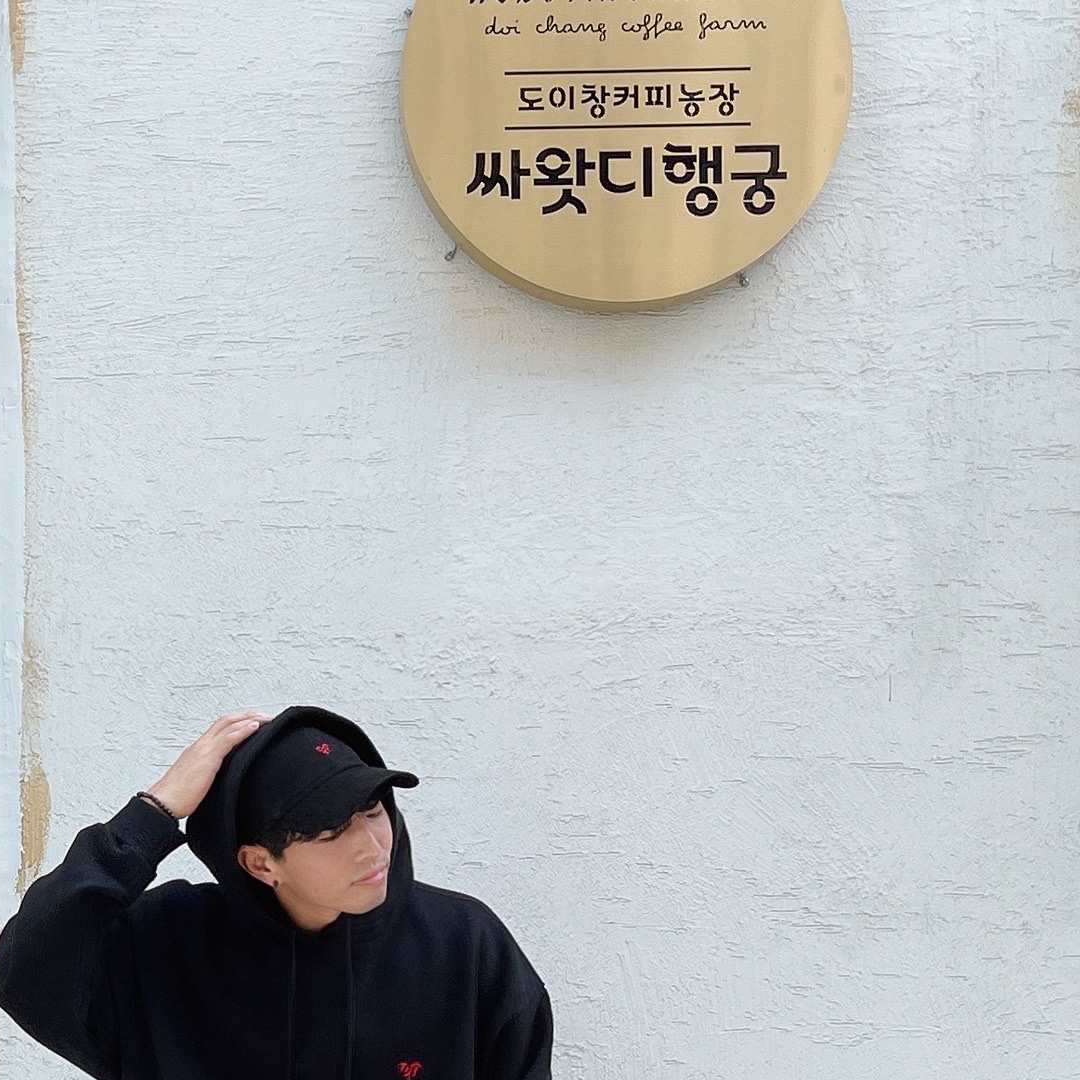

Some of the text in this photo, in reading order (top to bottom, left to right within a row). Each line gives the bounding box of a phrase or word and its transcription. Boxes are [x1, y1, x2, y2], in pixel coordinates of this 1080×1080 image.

[484, 13, 767, 41] doi chang coffee farm
[518, 83, 740, 119] 도이창커피농장
[466, 142, 788, 217] 싸왓디행궁
